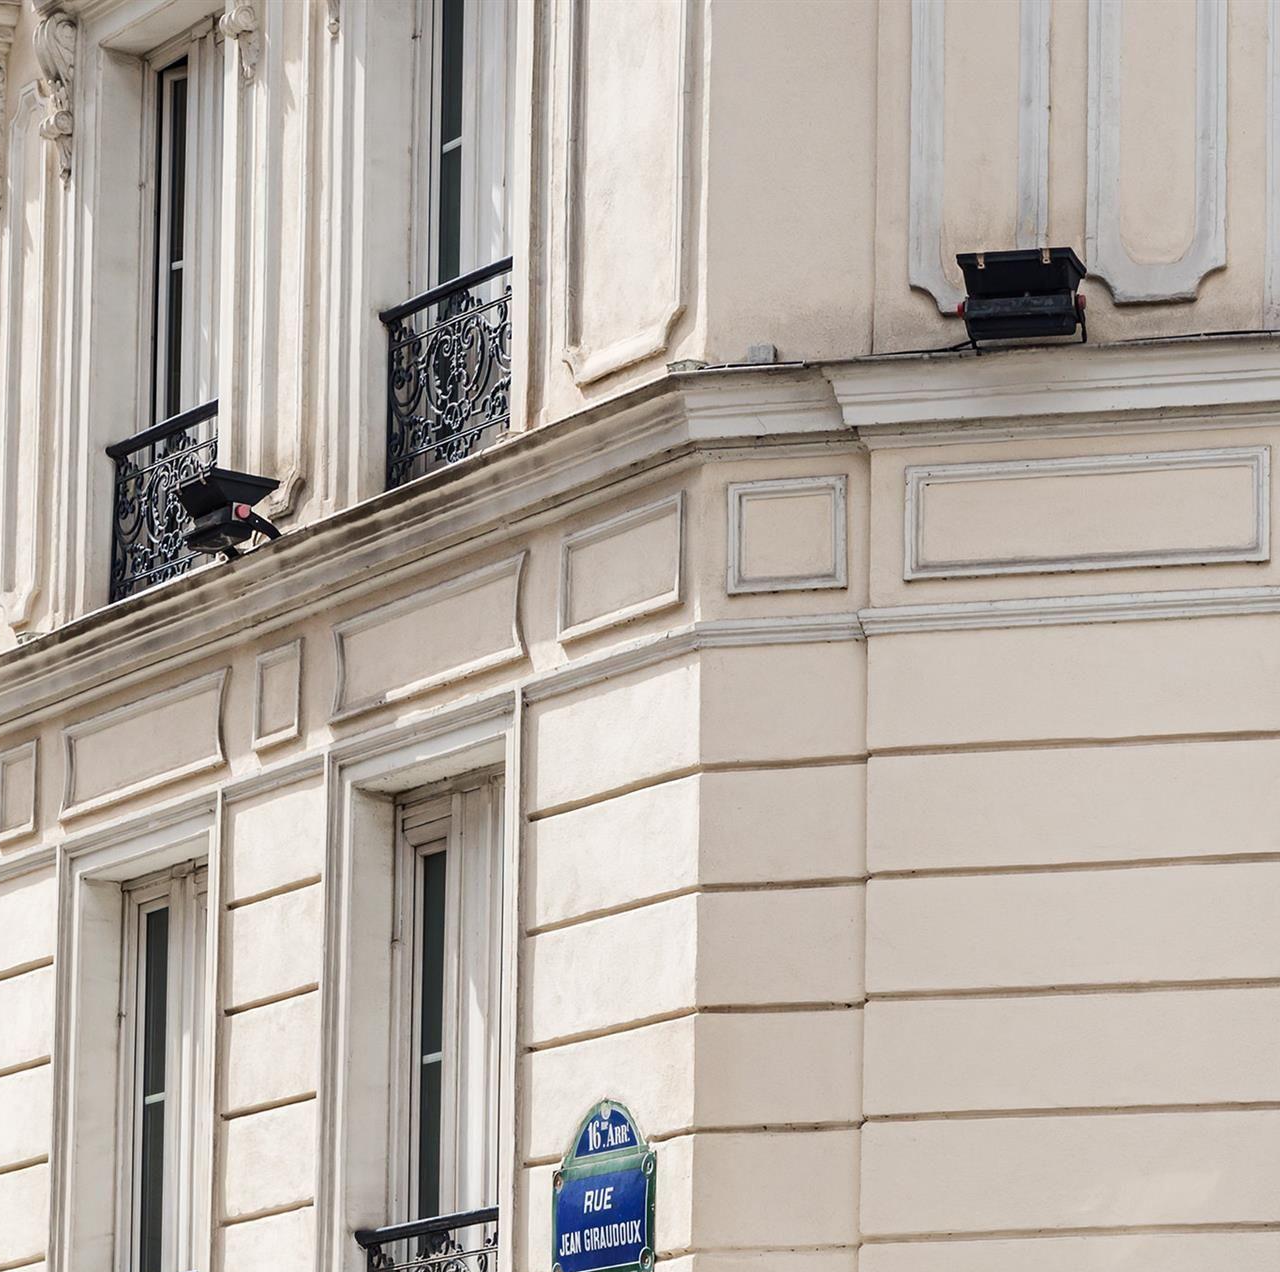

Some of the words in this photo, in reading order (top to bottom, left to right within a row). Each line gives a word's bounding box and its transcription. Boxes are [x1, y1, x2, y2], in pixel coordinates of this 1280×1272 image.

[583, 1187, 614, 1213] RUE
[560, 1230, 581, 1256] JEAN
[584, 1219, 642, 1250] GIRAUDOUX
